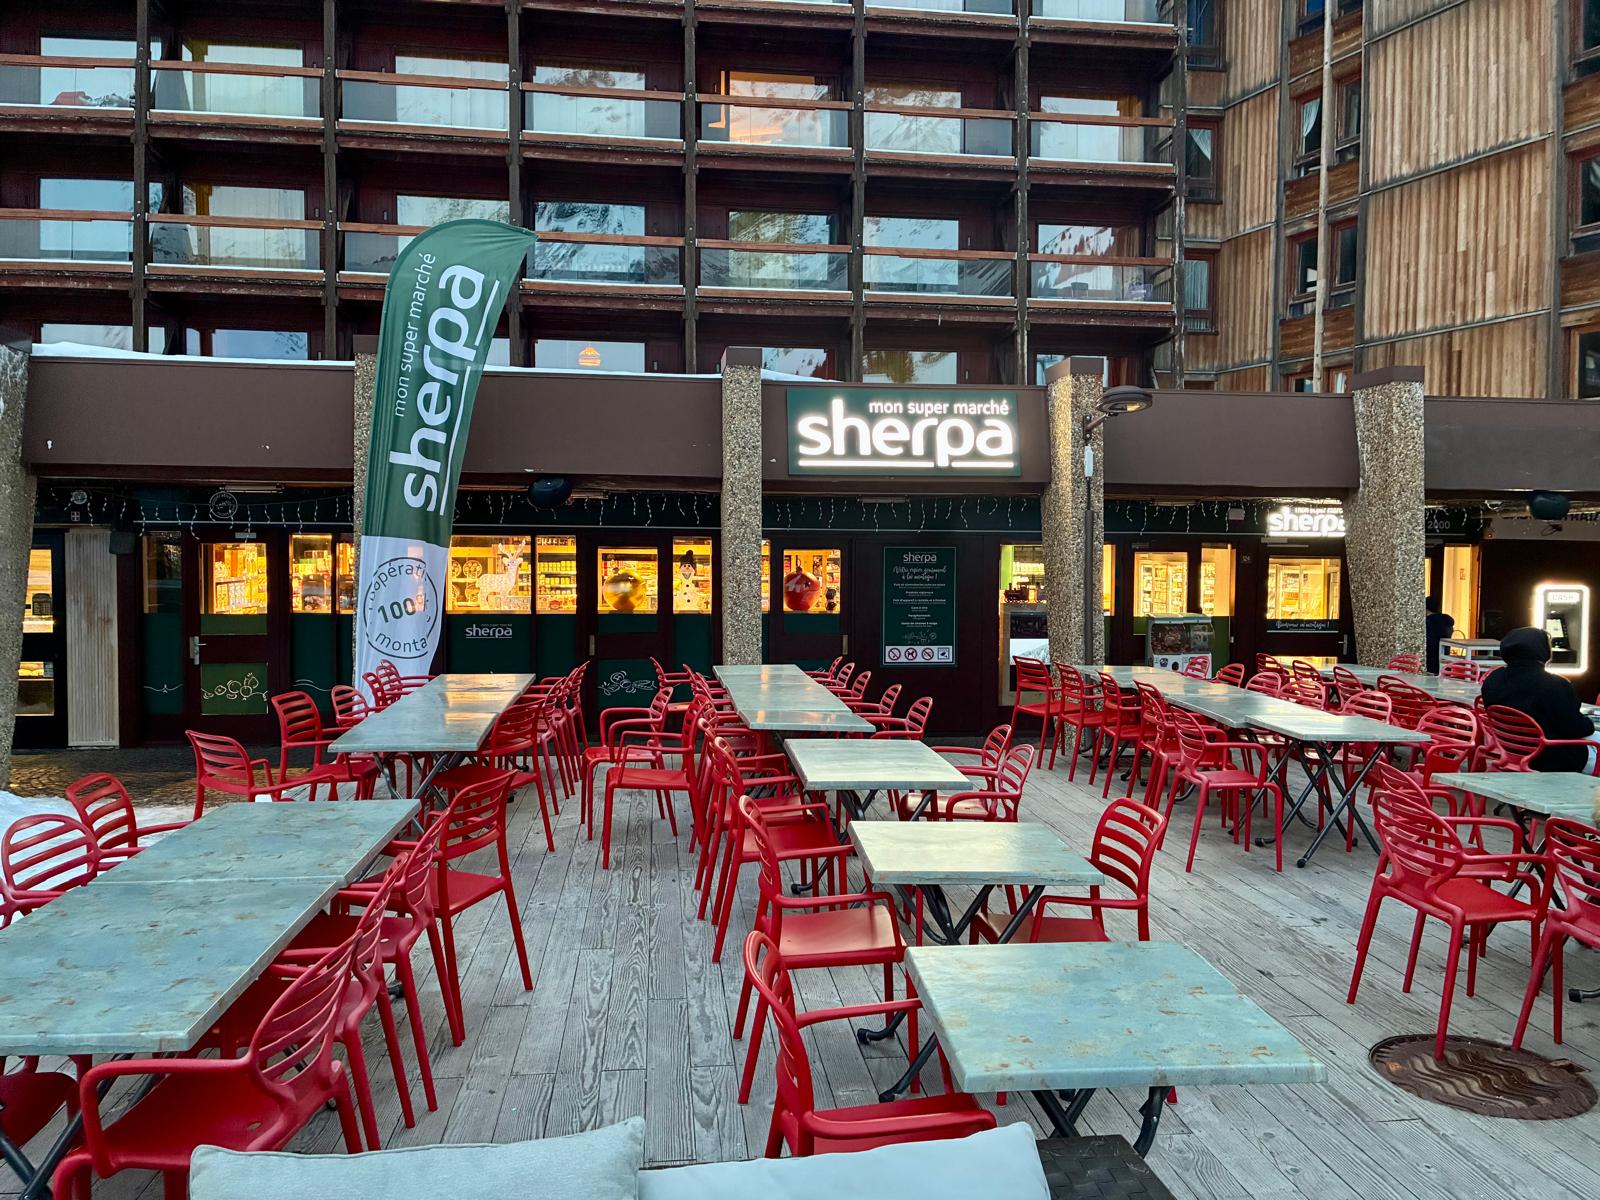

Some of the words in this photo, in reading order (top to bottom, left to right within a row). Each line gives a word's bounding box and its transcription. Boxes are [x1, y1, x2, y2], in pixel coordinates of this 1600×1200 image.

[409, 252, 436, 319] marché
[400, 322, 420, 373] super
[388, 264, 486, 512] sherpa
[394, 376, 410, 417] mon
[868, 402, 903, 414] mon
[907, 402, 949, 417] super
[953, 399, 1009, 415] marché
[797, 398, 1014, 467] sherpa
[903, 551, 937, 563] sherpa
[375, 632, 429, 653] monta
[465, 623, 513, 639] sherpa
